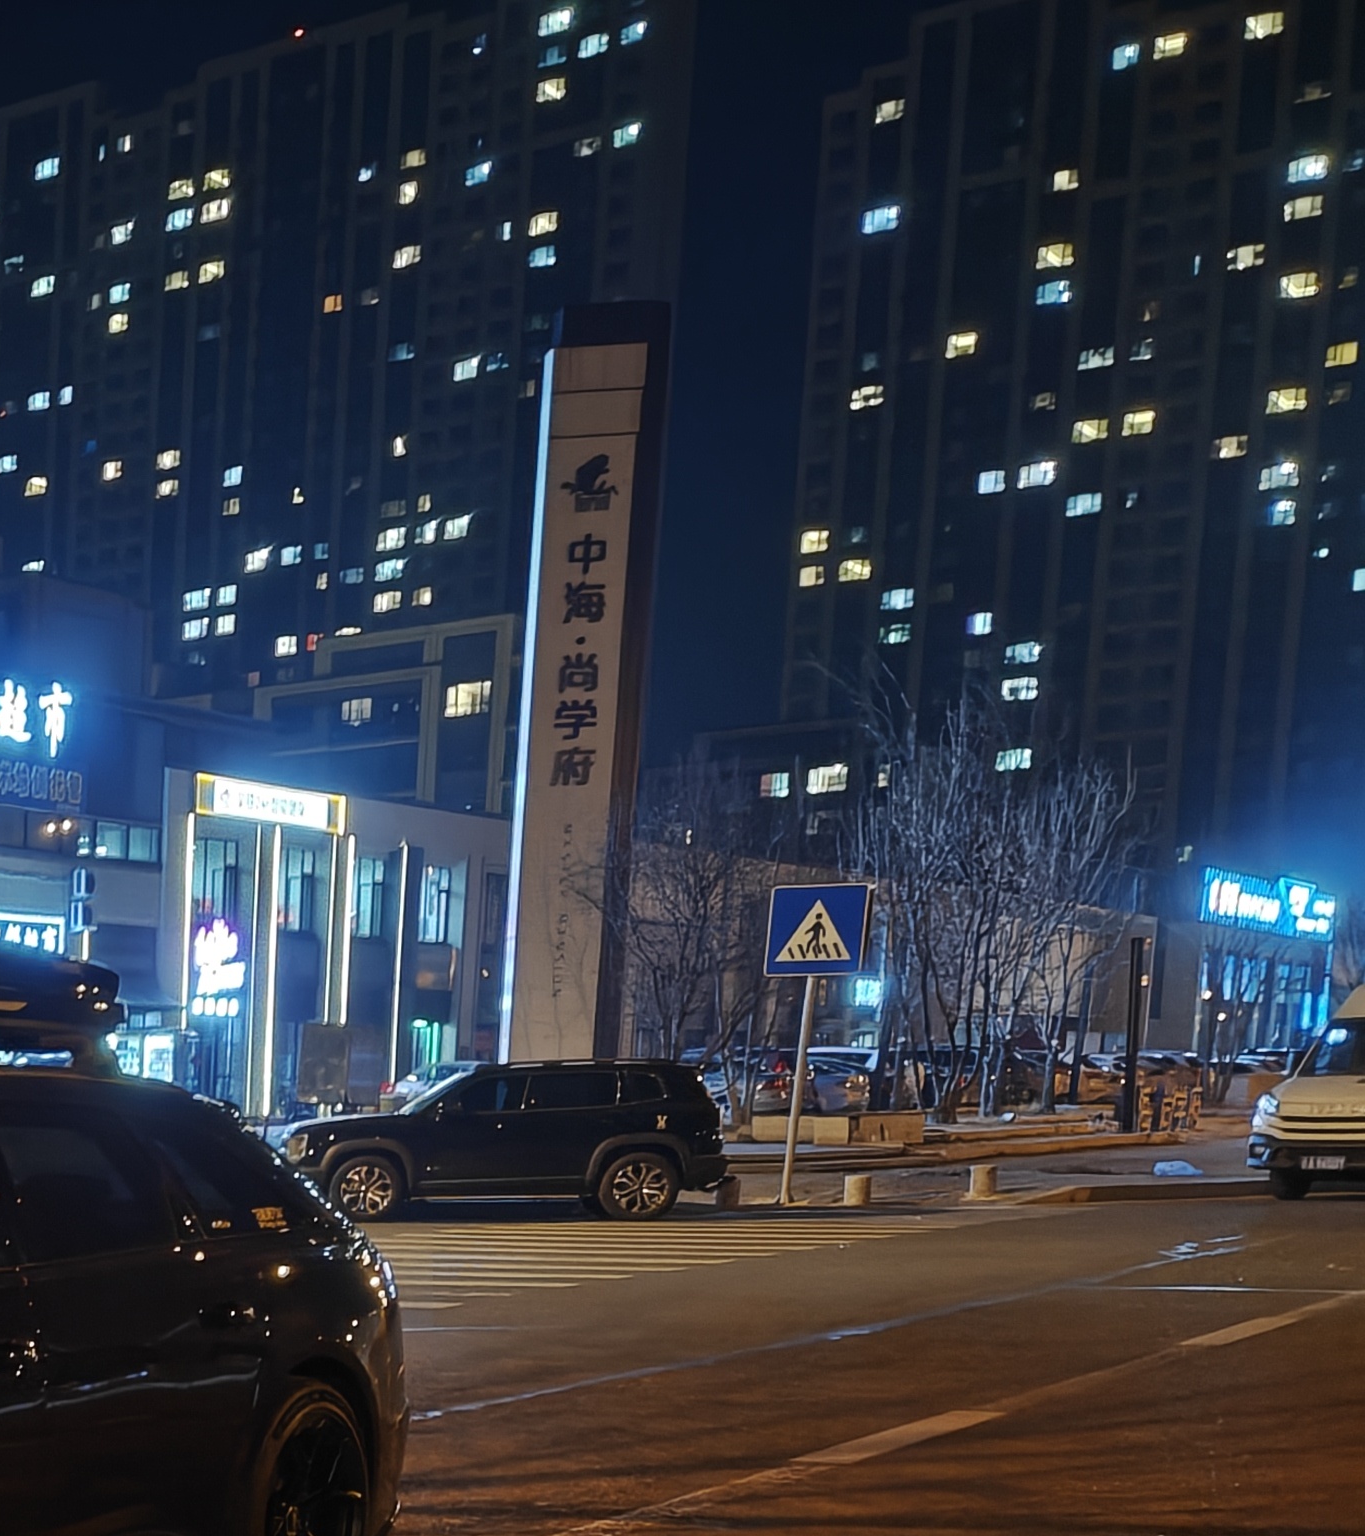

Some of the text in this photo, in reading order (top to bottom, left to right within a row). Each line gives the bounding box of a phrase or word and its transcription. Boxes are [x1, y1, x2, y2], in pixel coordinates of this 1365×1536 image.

[549, 533, 607, 787] 中海·尚学府
